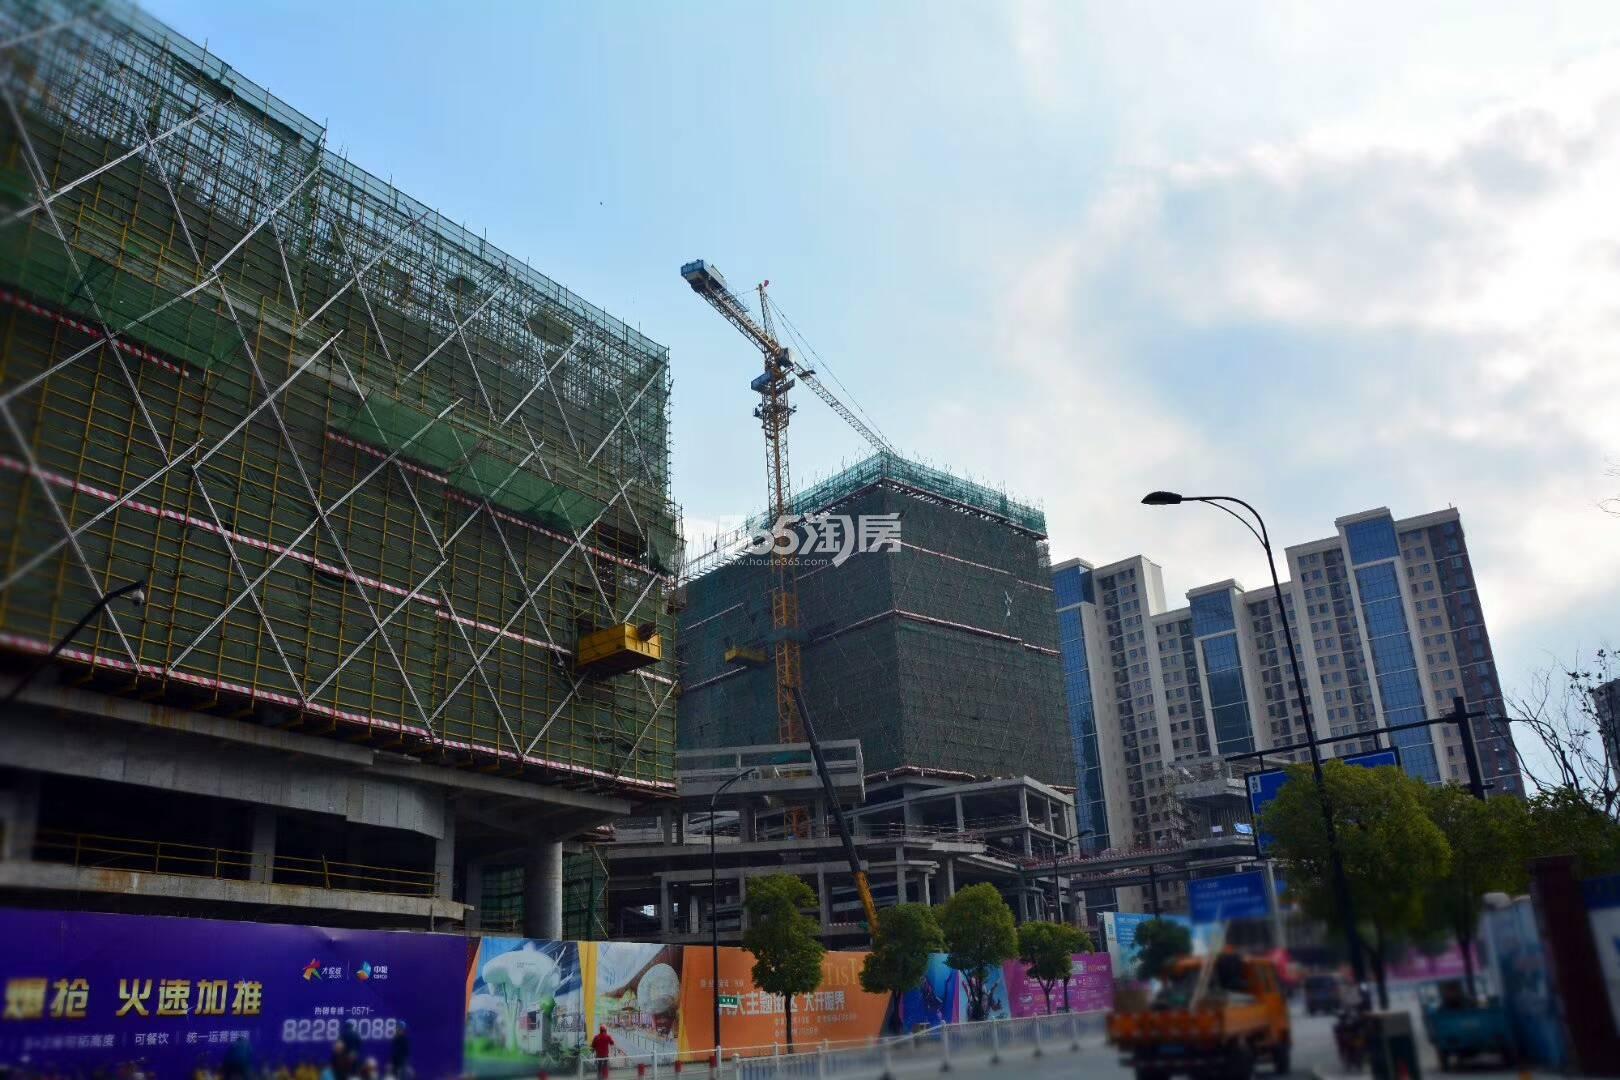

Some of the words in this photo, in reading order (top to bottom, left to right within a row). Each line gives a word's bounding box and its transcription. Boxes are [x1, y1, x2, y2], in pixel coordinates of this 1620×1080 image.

[115, 977, 263, 1017] 火速加推
[135, 1032, 169, 1047] 可餐饮
